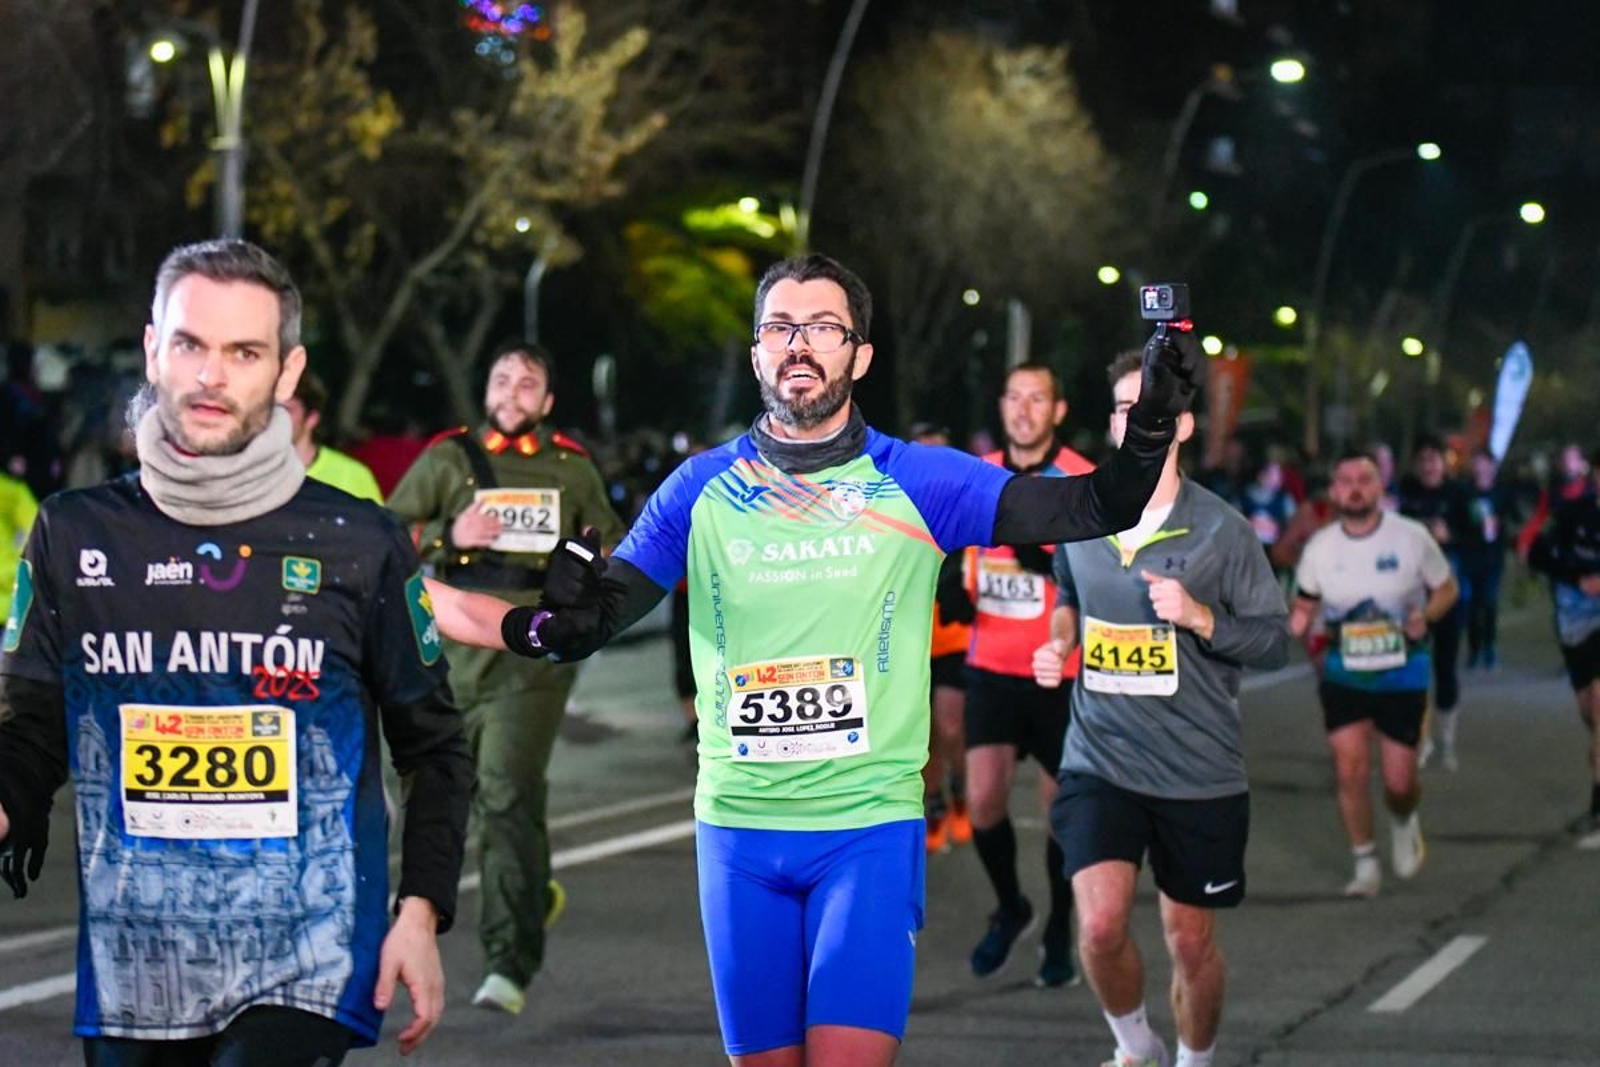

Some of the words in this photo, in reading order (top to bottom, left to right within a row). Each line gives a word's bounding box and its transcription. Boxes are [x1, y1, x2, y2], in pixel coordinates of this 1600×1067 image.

[761, 535, 876, 562] SAKATA
[144, 557, 193, 586] jaén
[748, 569, 808, 584] PASSION
[810, 569, 822, 580] in
[826, 565, 857, 579] Seed
[877, 590, 896, 673] Atletismo
[82, 631, 154, 675] SAN
[167, 625, 325, 679] ANTÓN
[1090, 642, 1167, 669] 4145
[251, 666, 321, 701] 2025
[757, 666, 778, 684] 42
[739, 684, 853, 724] 5389
[154, 714, 183, 735] 42
[134, 744, 276, 788] 3280
